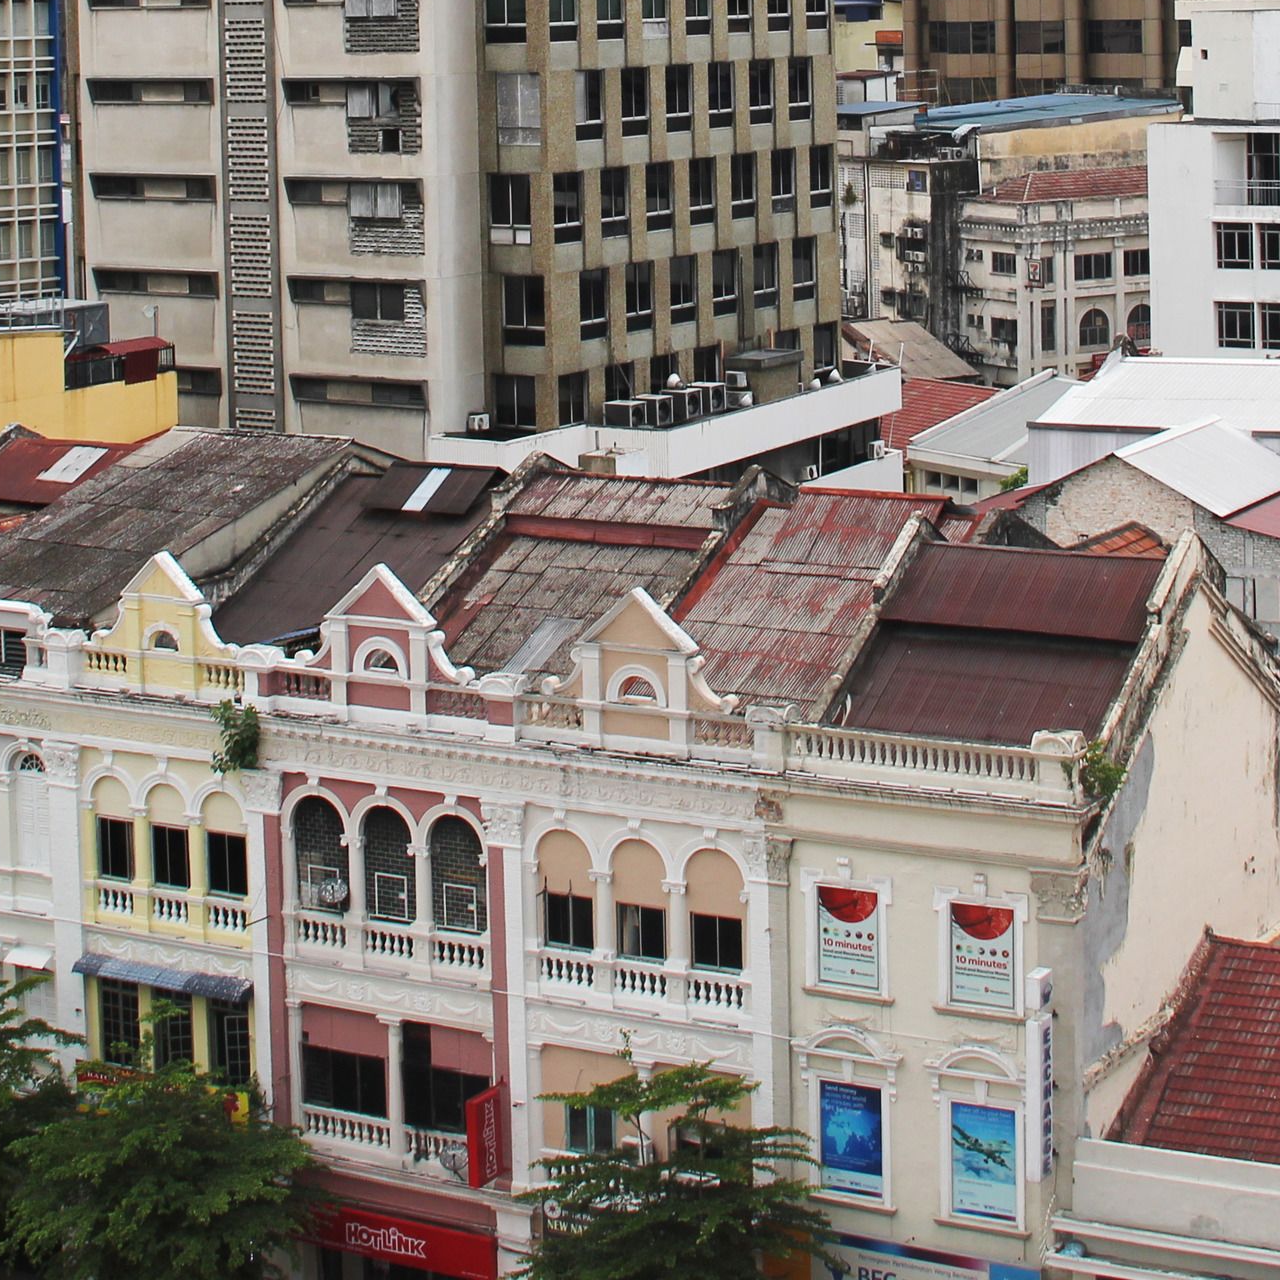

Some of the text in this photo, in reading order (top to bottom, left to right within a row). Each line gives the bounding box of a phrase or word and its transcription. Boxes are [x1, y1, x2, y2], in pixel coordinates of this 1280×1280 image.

[823, 937, 834, 947] 10
[956, 955, 967, 964] 10
[1043, 1026, 1052, 1176] EXCHANGE
[547, 1219, 569, 1232] NEW
